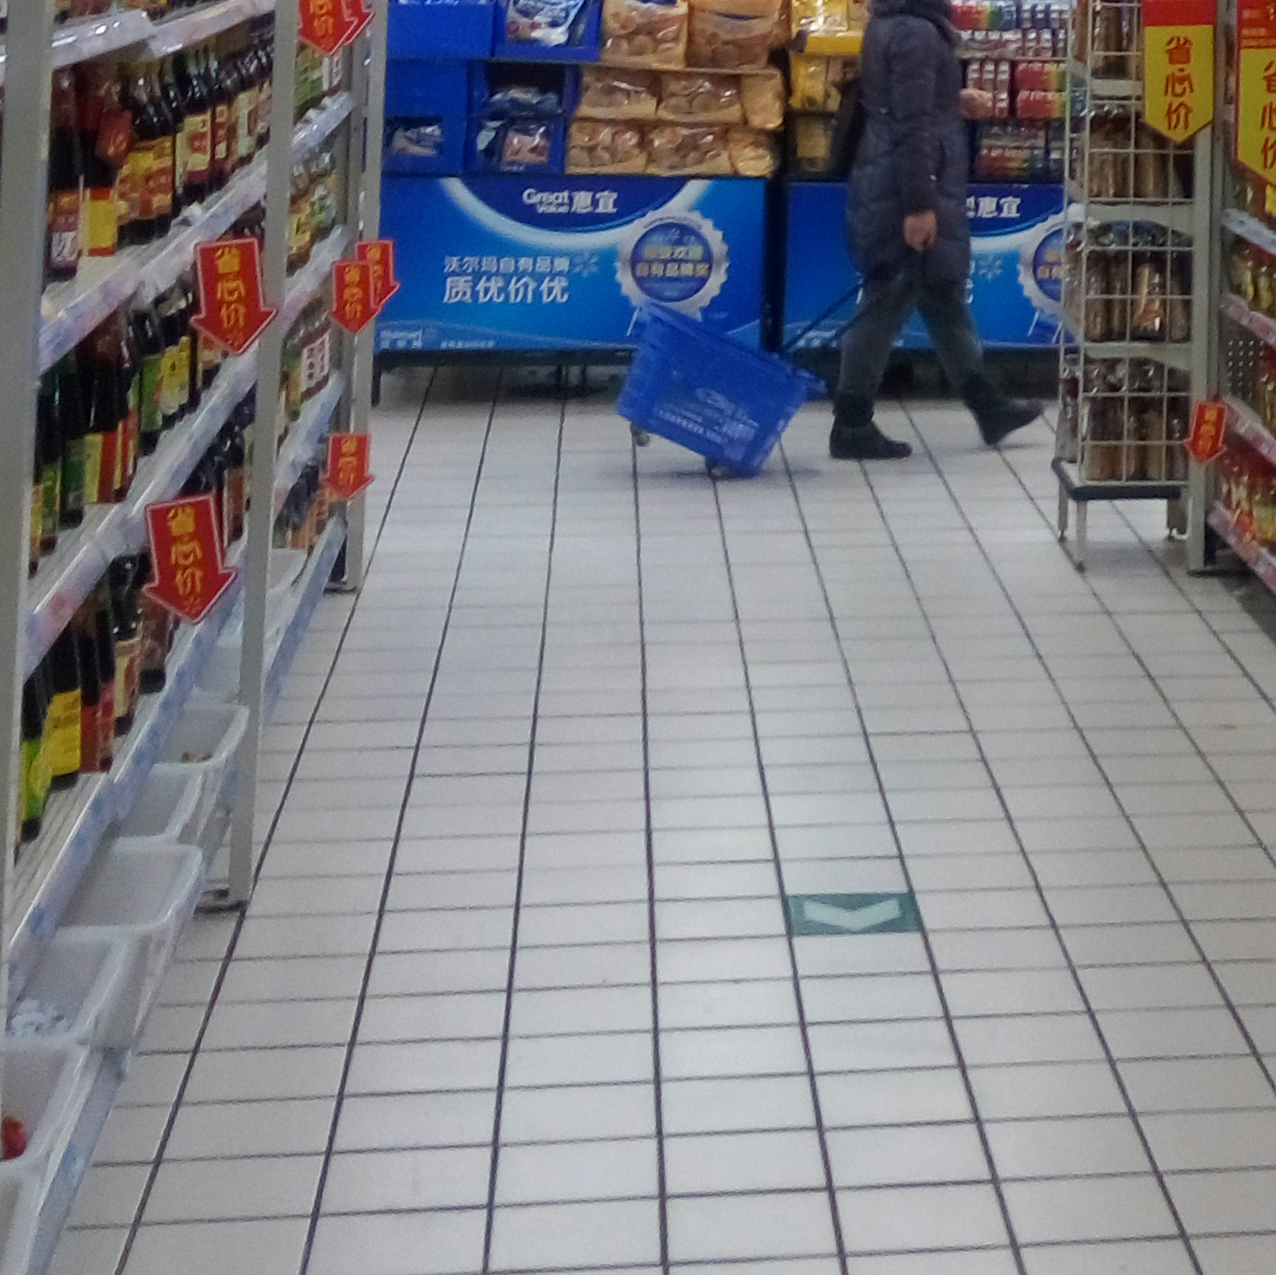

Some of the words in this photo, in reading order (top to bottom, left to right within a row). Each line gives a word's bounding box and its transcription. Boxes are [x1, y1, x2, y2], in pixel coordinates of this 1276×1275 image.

[1164, 35, 1195, 133] 省心价
[443, 275, 570, 304] 质优价优
